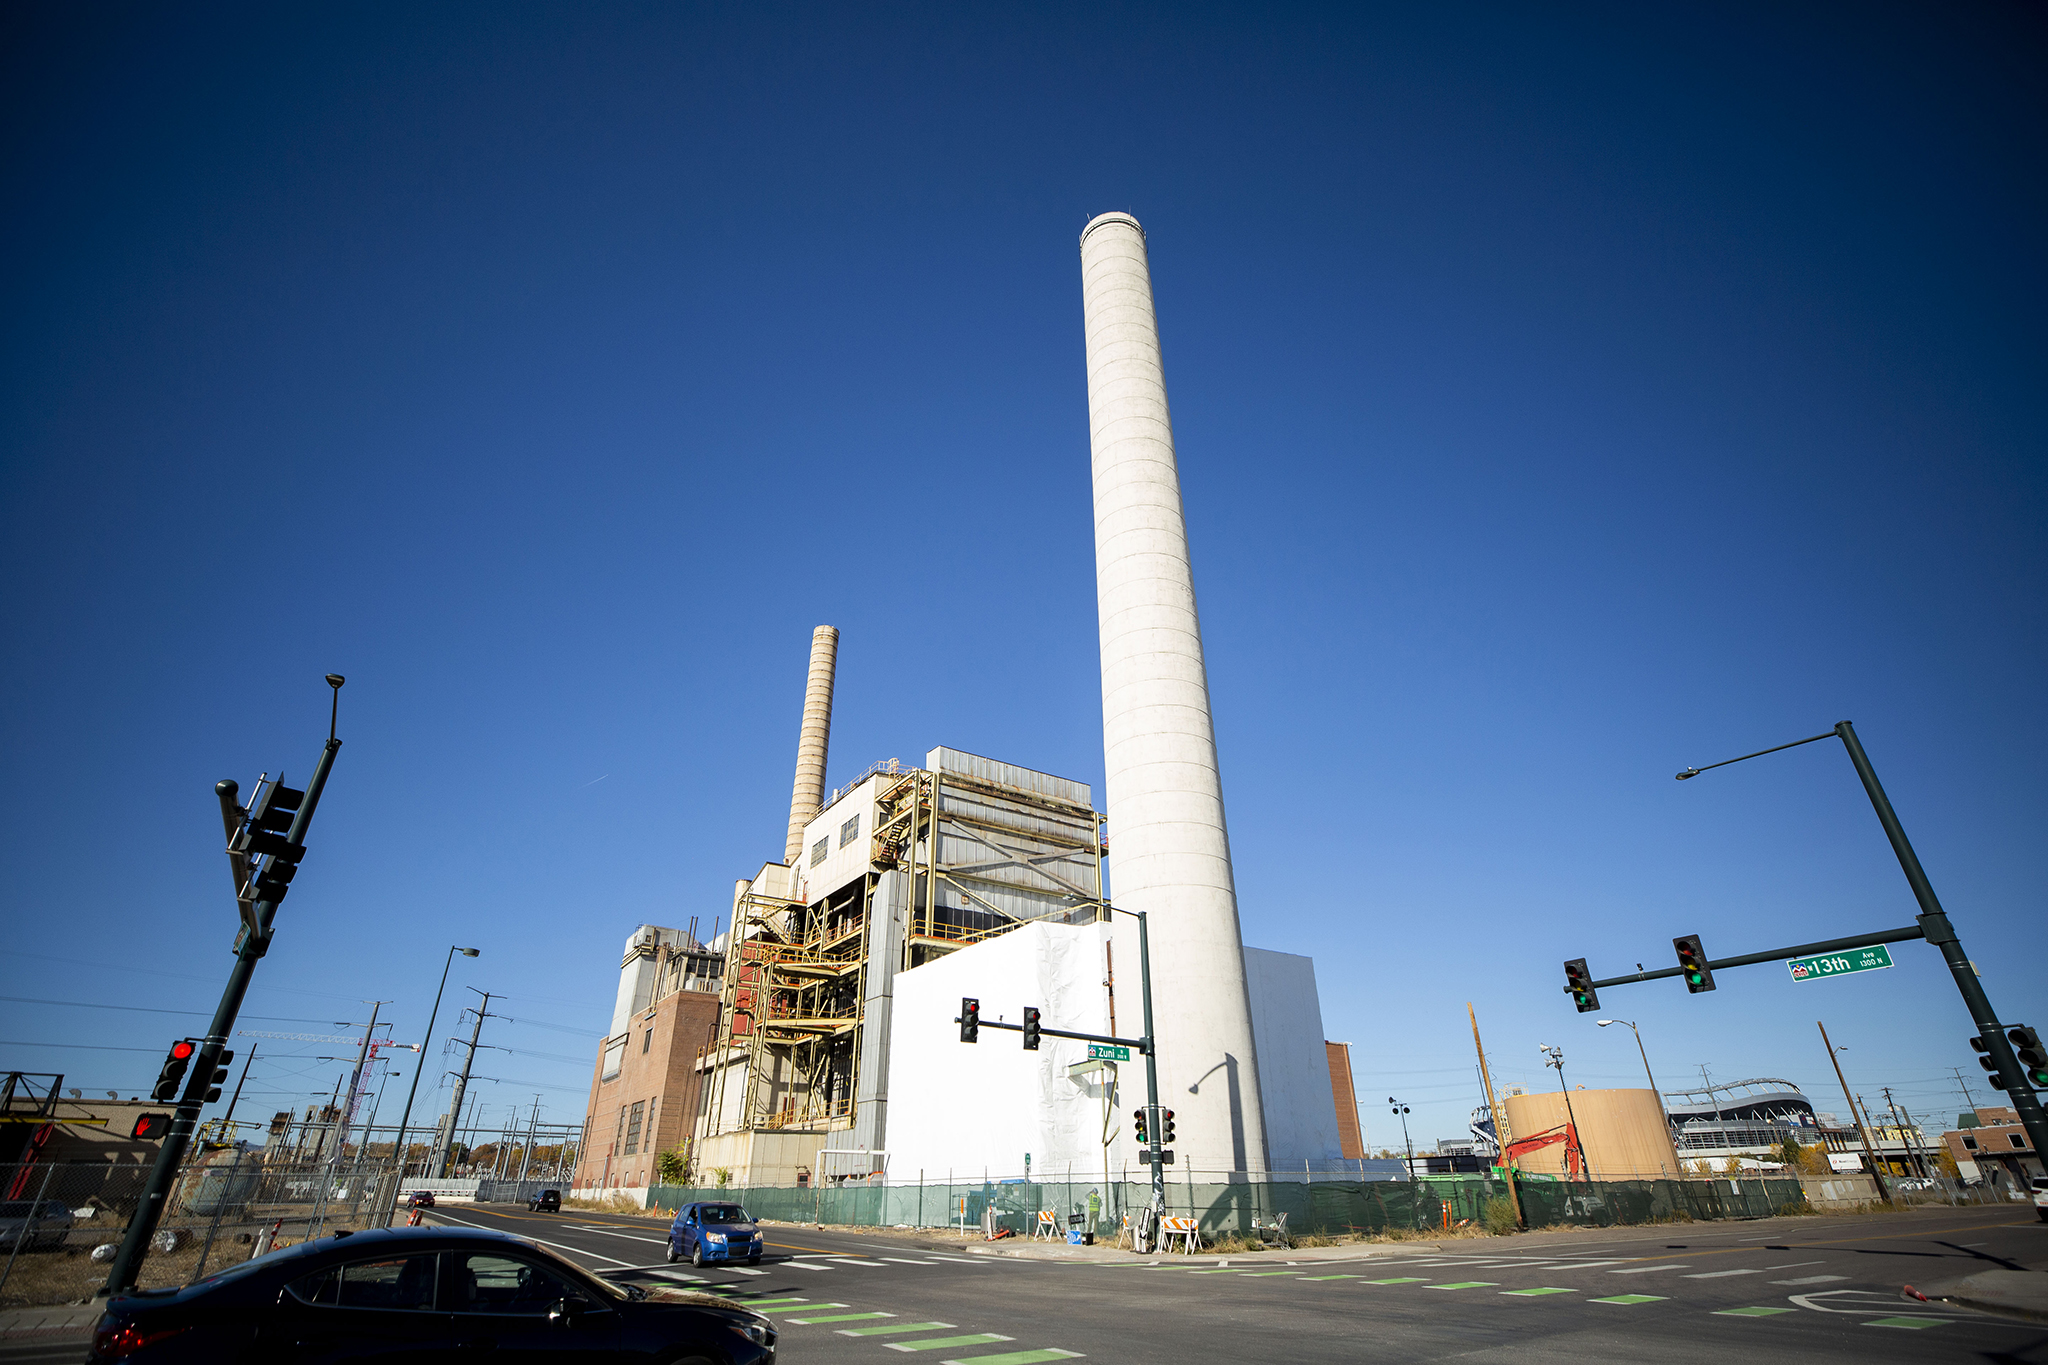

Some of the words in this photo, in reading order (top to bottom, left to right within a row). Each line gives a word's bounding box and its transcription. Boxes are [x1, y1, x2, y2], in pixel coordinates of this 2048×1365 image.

[1812, 956, 1851, 974] 13th
[1859, 959, 1876, 967] 1300
[1098, 1047, 1115, 1058] Zuni
